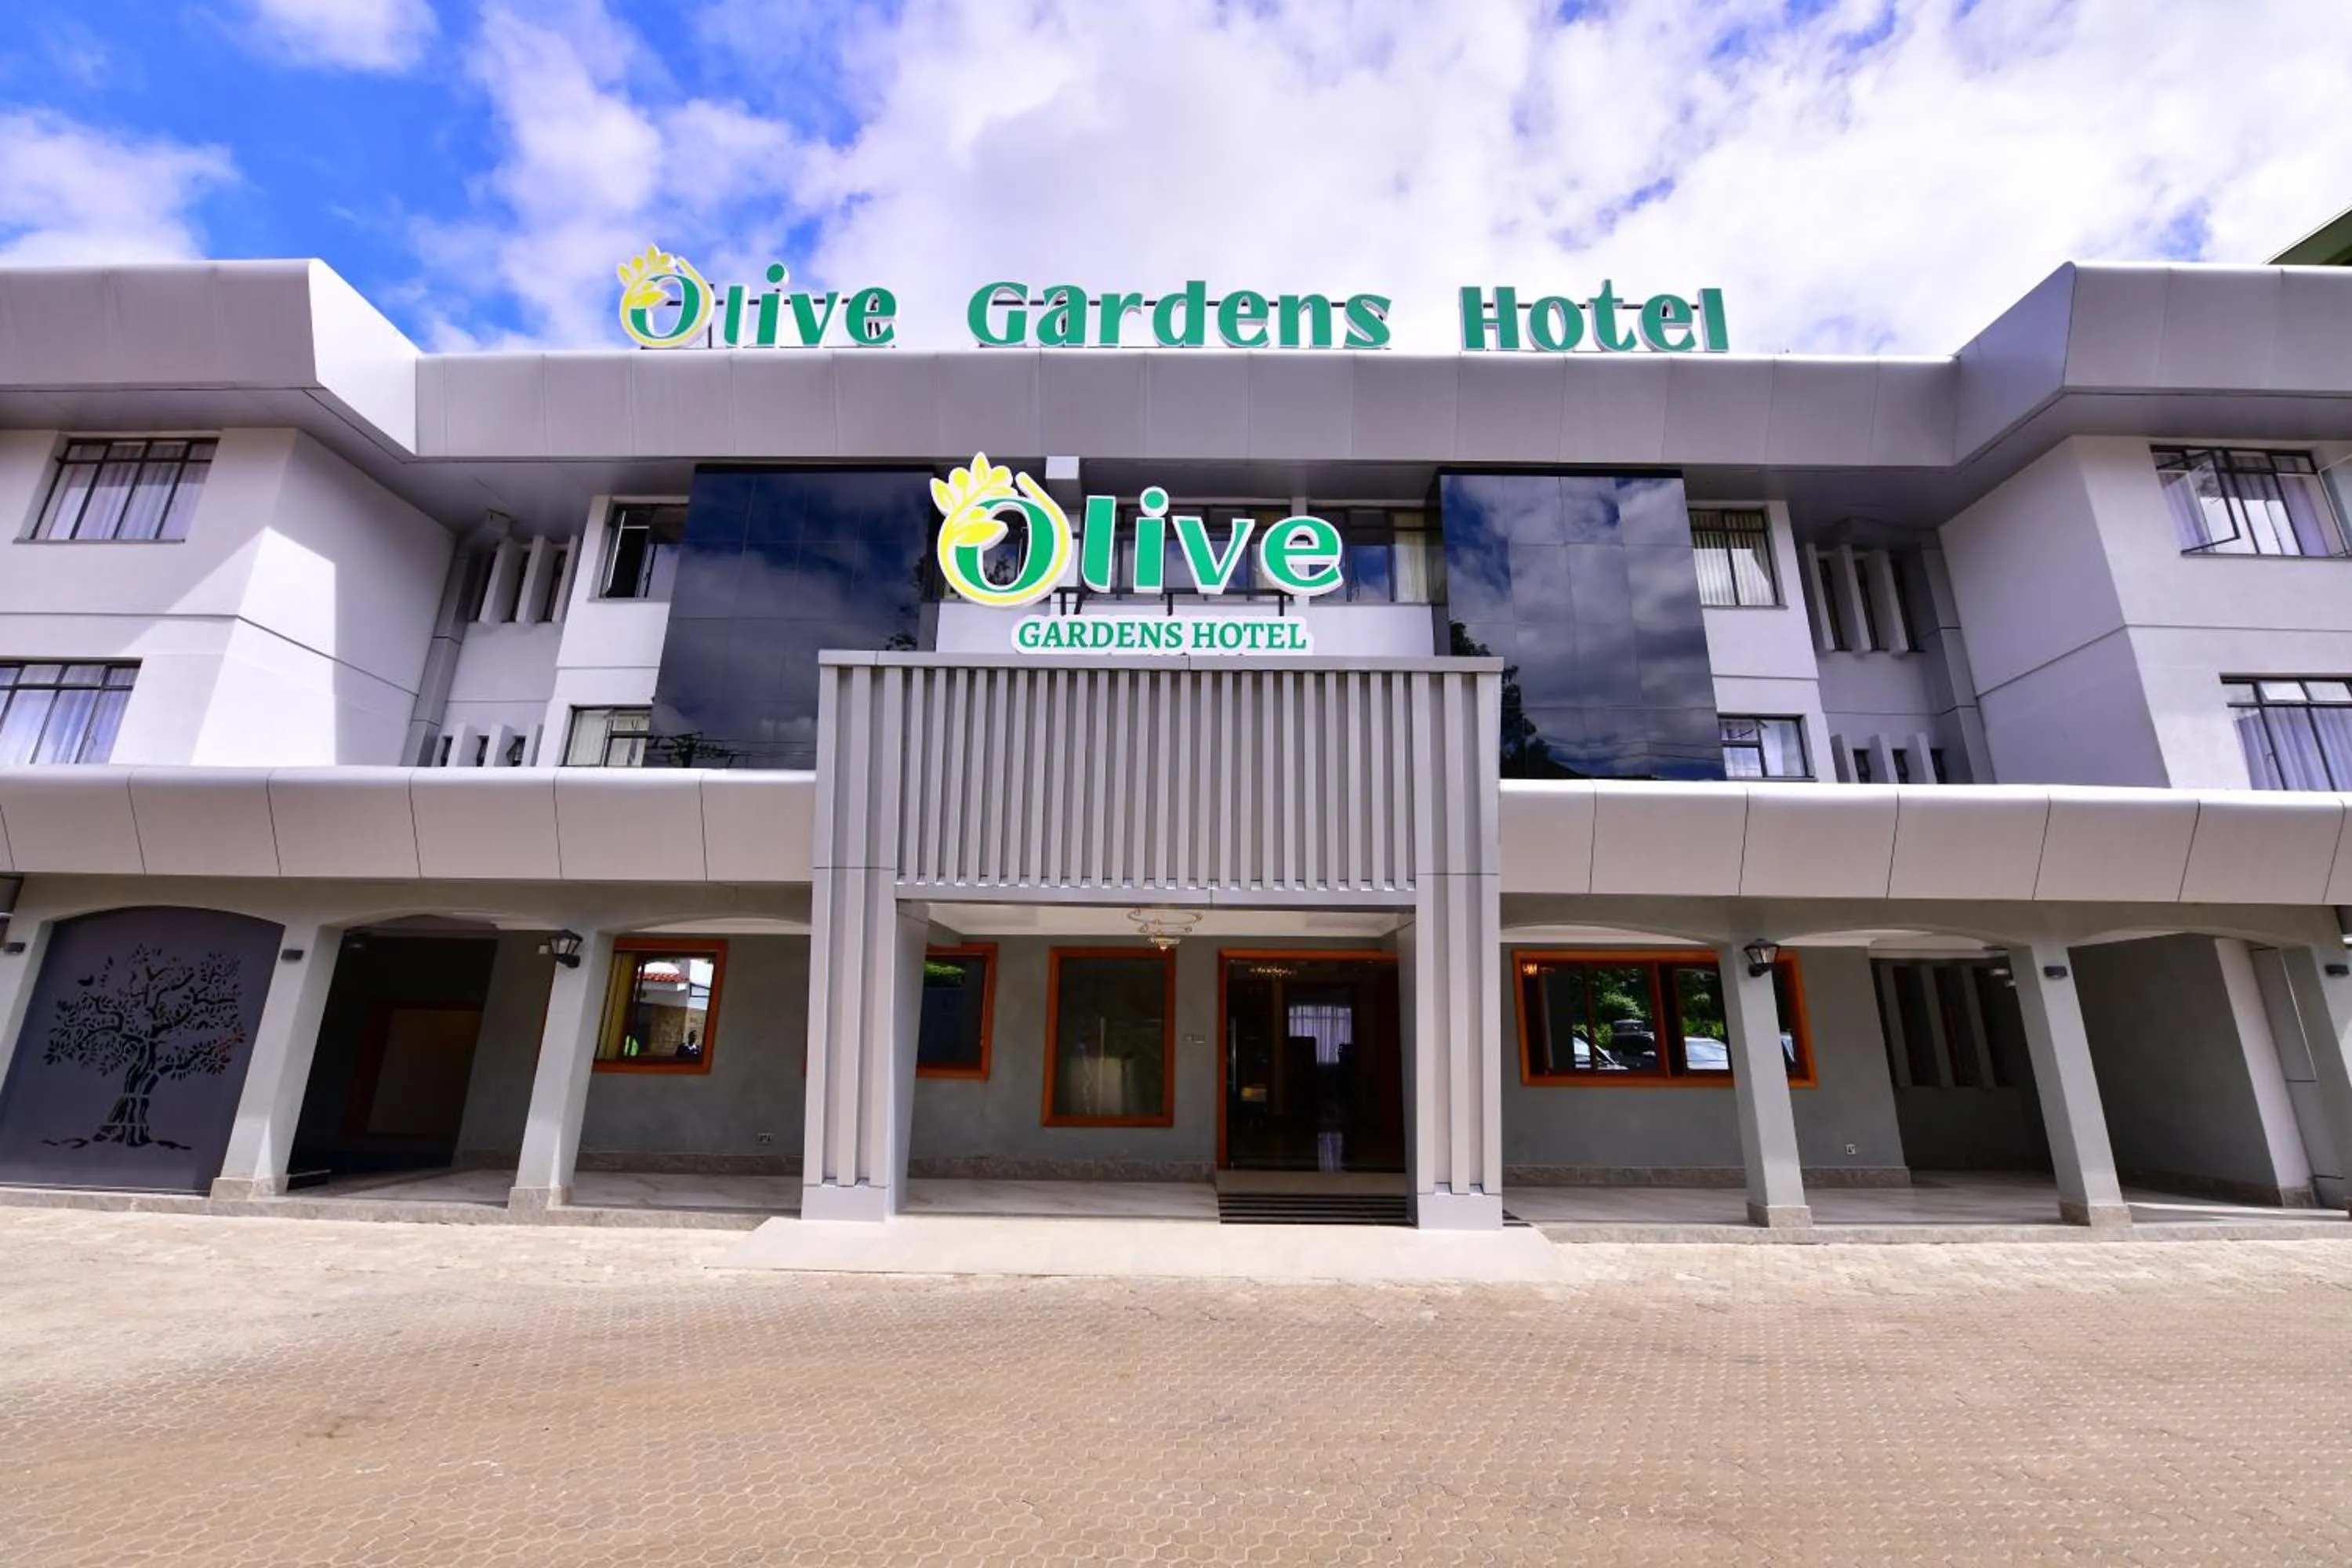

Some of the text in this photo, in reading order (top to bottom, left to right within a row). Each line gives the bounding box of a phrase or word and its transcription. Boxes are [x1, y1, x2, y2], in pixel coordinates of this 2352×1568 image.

[619, 259, 1730, 353] Olive Gardens Hotel
[938, 485, 1343, 607] Olive
[1018, 620, 1307, 650] GARDENS HOTEL
